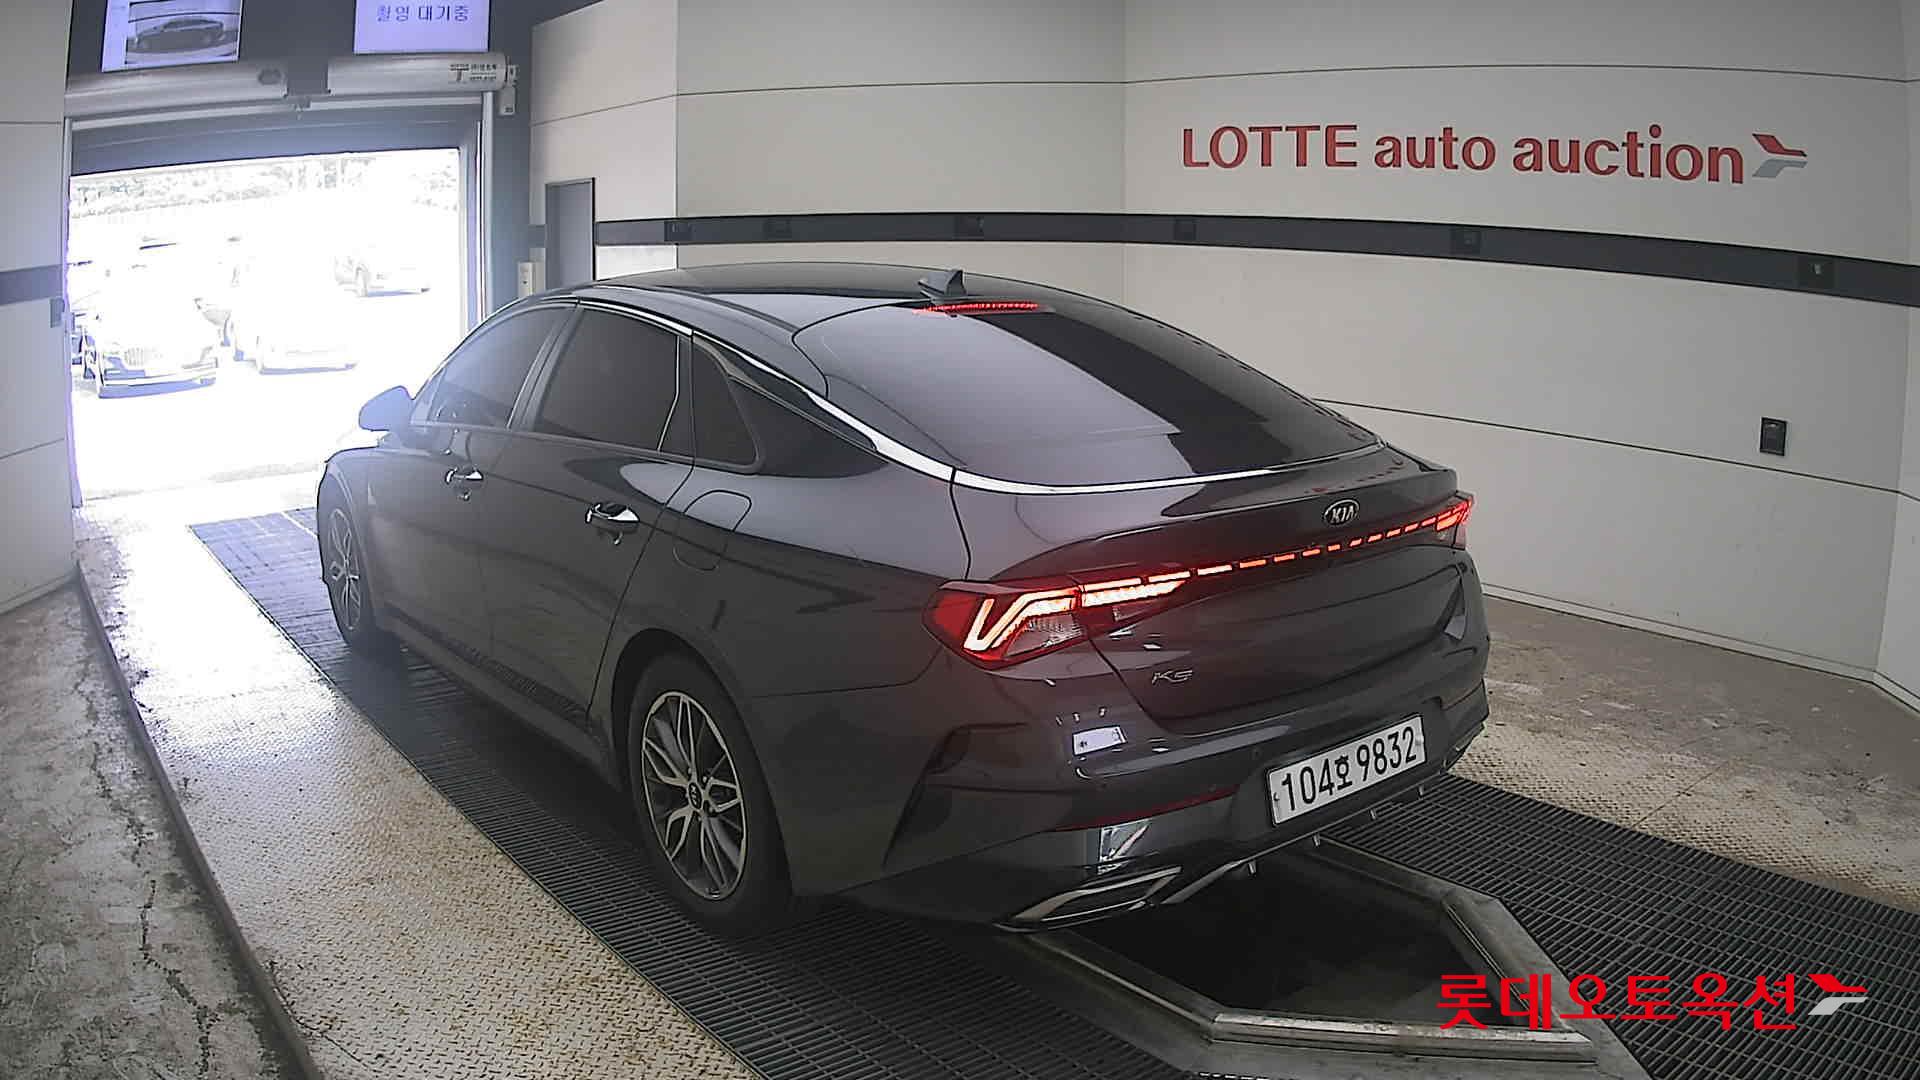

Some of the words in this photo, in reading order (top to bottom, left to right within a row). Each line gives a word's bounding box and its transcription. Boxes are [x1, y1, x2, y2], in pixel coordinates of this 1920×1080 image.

[418, 5, 468, 21] 대기중
[1183, 124, 1358, 169] LOTTE
[1373, 127, 1496, 171] auto
[1512, 124, 1744, 184] auction
[1329, 505, 1355, 524] KIA
[1151, 669, 1193, 684] K5
[1356, 726, 1417, 782] 9832
